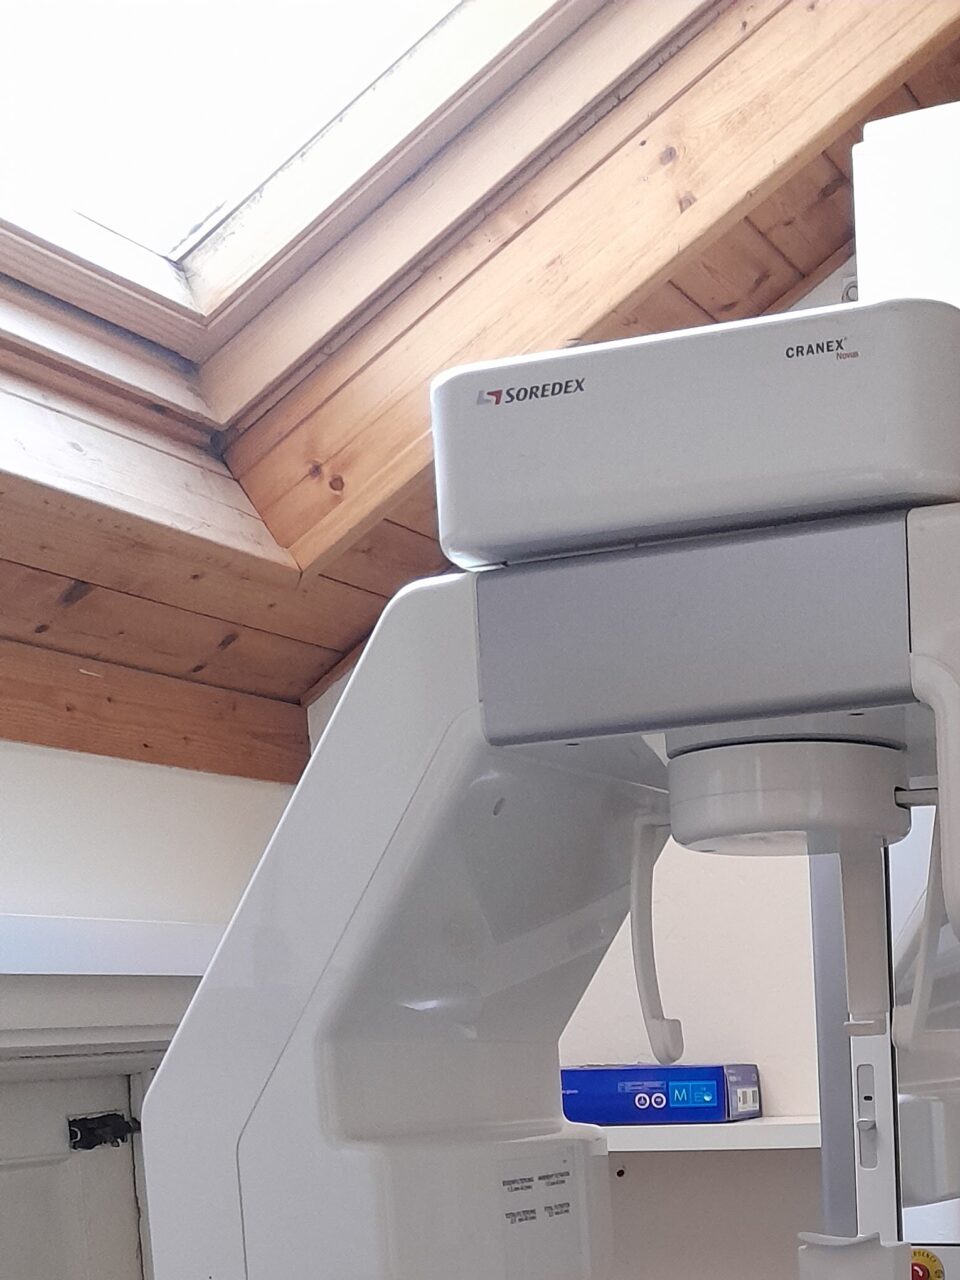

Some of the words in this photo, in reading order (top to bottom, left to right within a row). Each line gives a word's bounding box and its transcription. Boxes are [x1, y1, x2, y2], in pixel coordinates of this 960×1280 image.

[785, 339, 844, 358] CRANEX
[505, 378, 585, 403] SOREDEX
[674, 1088, 687, 1102] M
